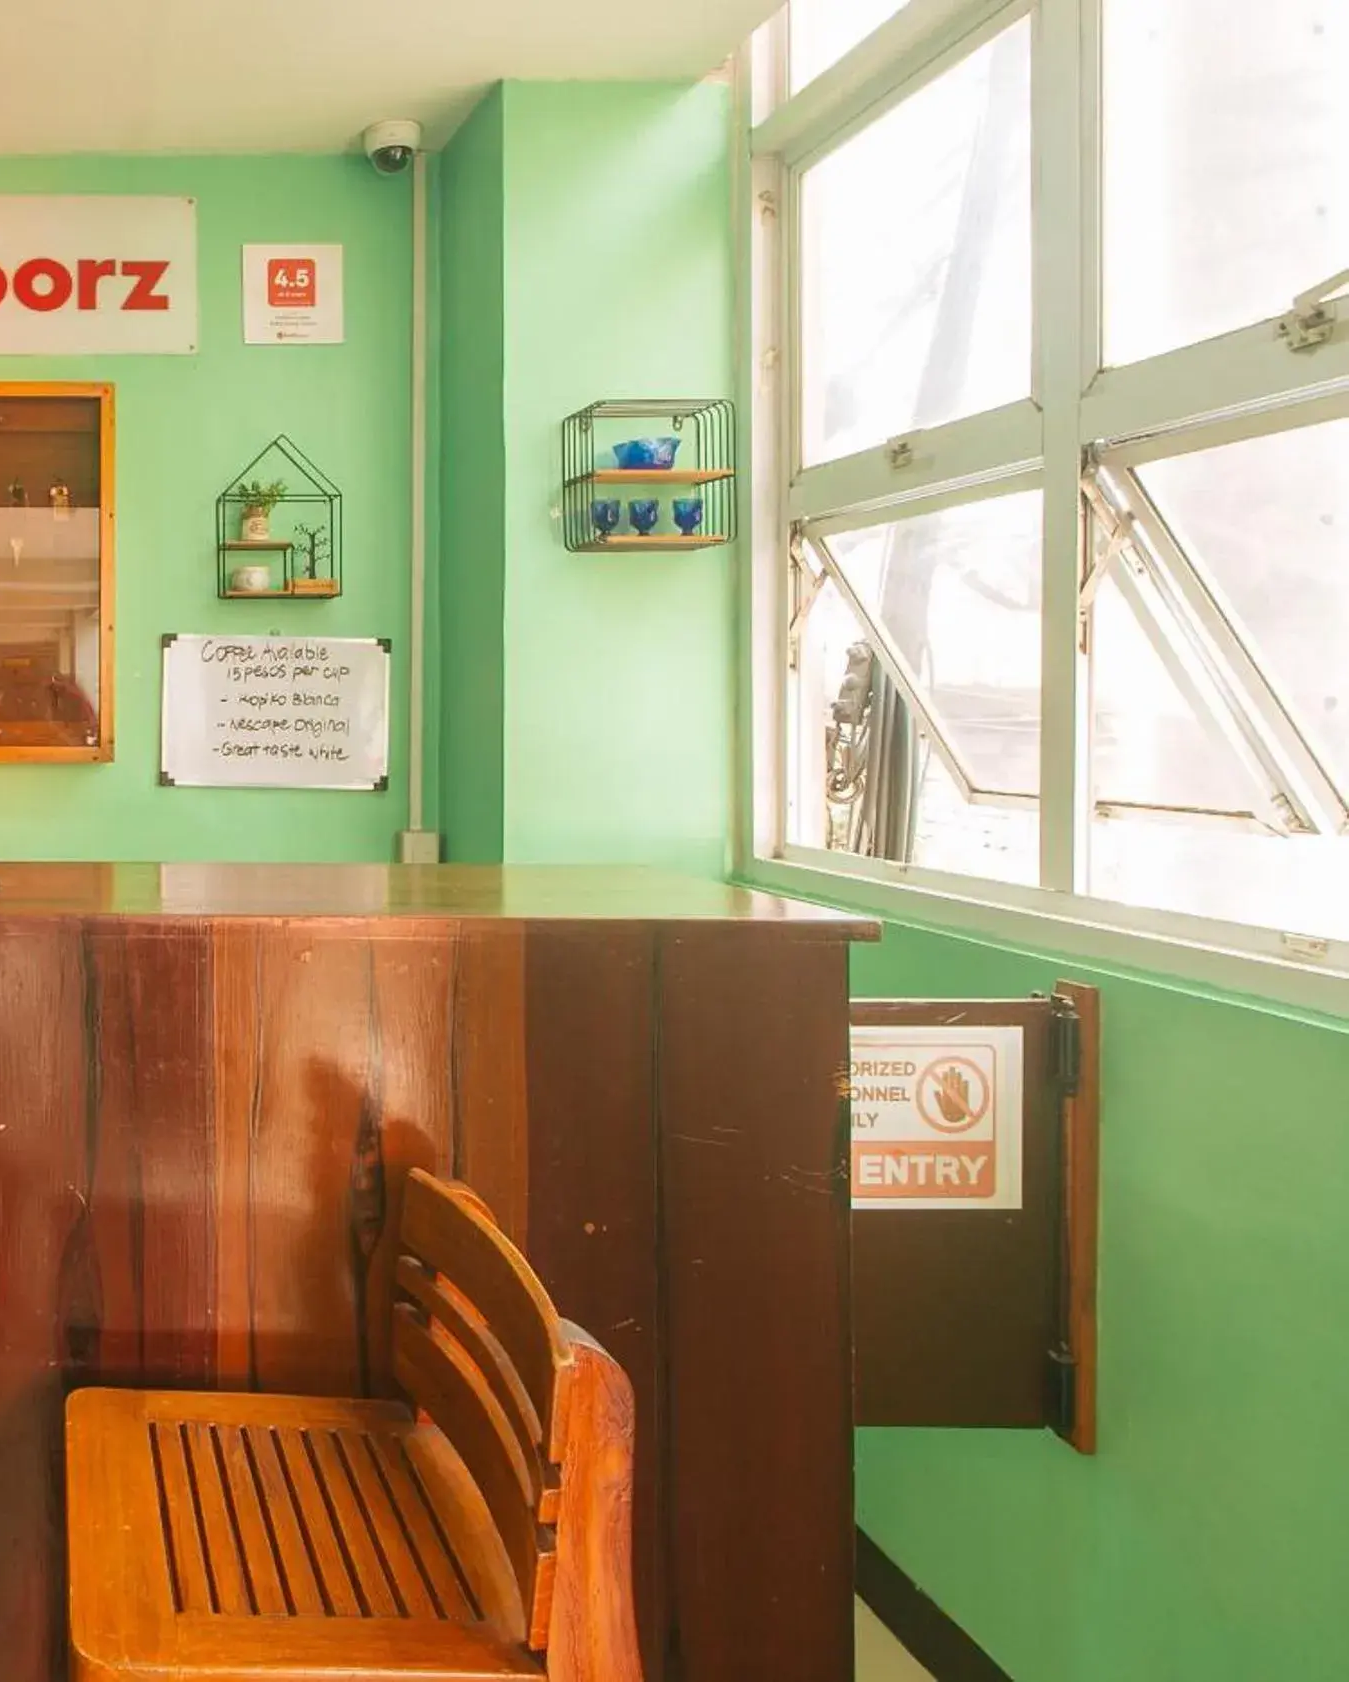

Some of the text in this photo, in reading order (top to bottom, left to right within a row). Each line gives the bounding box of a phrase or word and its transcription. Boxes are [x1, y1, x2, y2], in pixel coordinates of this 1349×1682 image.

[274, 268, 310, 288] 4.5
[851, 1112, 879, 1128] LY
[858, 1154, 989, 1186] ENTRY
